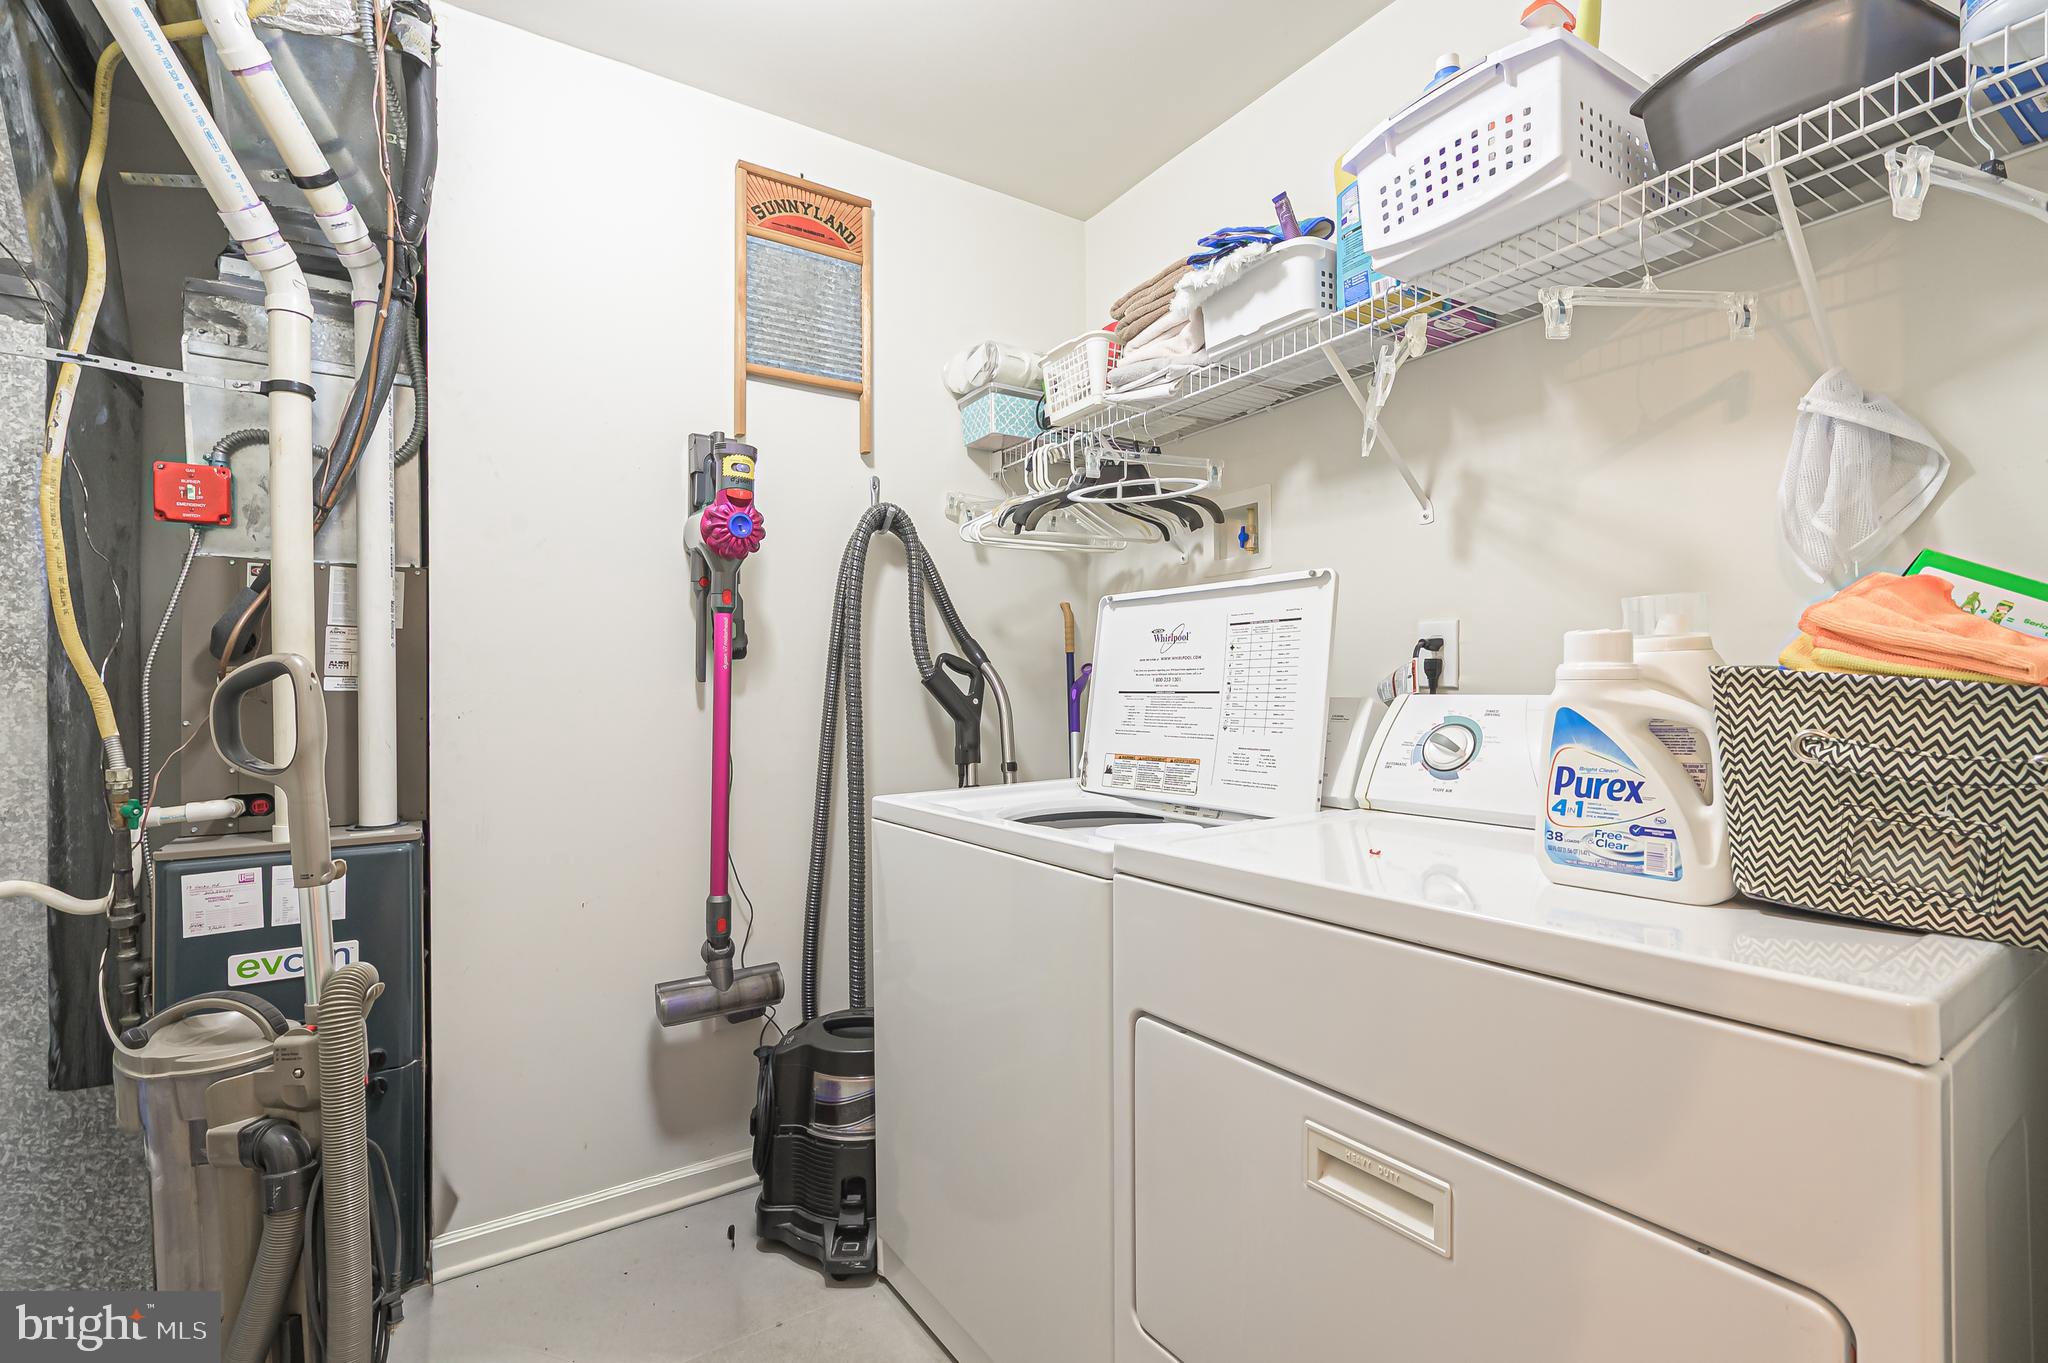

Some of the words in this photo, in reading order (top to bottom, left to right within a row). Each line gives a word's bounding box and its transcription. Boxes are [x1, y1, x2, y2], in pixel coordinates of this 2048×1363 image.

[751, 199, 857, 244] SUNNYLAND
[1153, 632, 1189, 644] Whirlpool
[1554, 766, 1645, 804] Purex
[1546, 830, 1564, 842] 38
[1594, 829, 1623, 840] Free
[1595, 839, 1629, 851] Clear
[236, 946, 350, 979] evcn
[1345, 1149, 1371, 1170] HEAVY
[1378, 1165, 1400, 1185] DUTY
